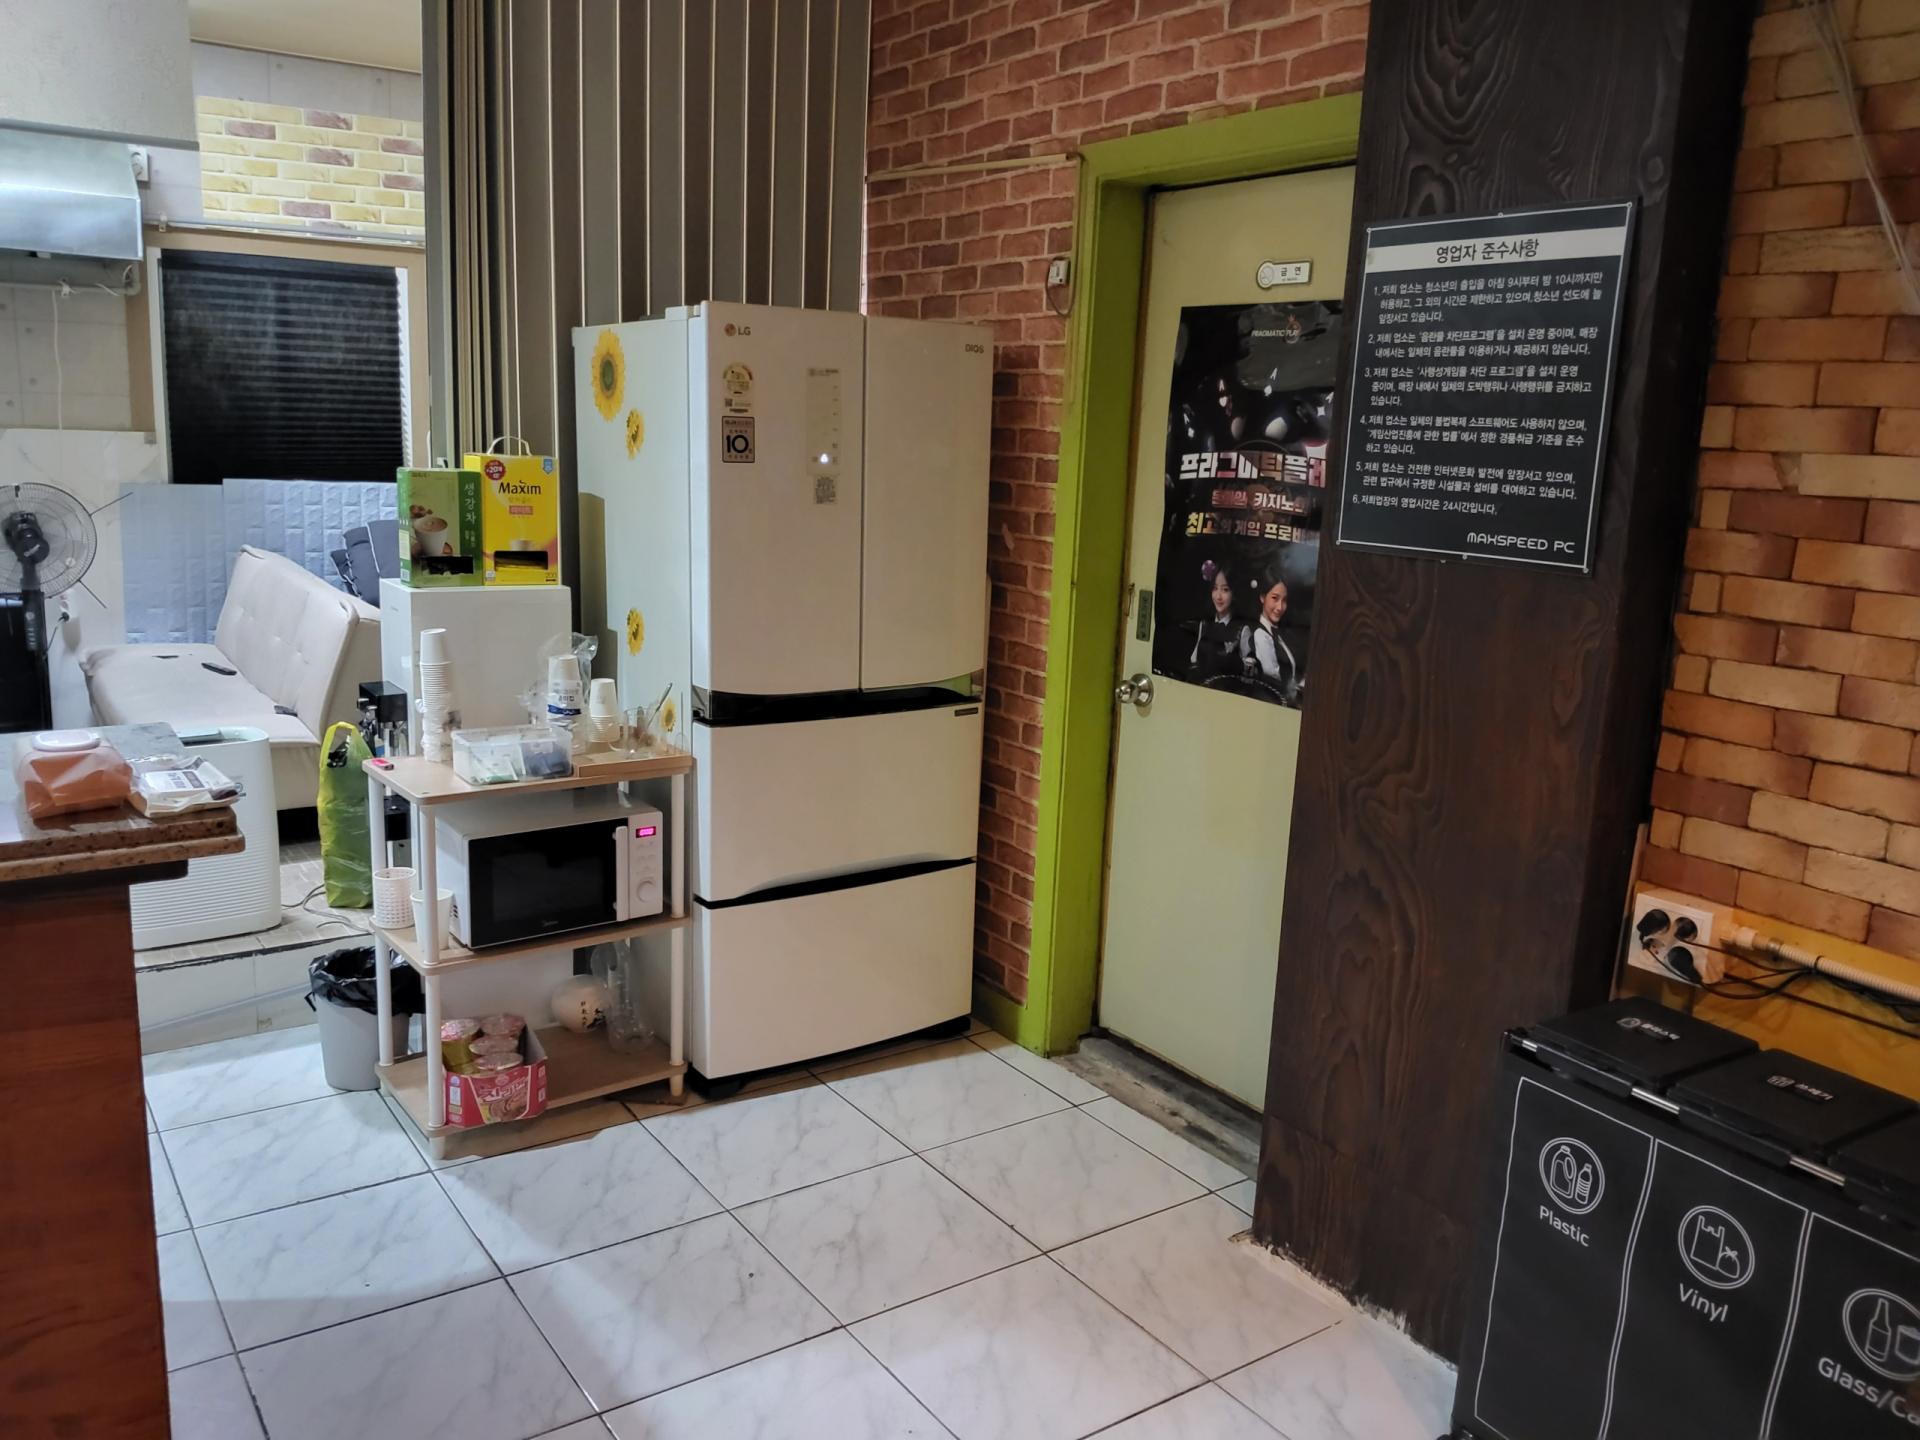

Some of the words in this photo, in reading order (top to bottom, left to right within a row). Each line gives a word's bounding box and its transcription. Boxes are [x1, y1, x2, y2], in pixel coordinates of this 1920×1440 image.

[1437, 243, 1477, 264] 영업자
[1482, 238, 1540, 260] 준수사항
[1382, 283, 1397, 295] 저희
[1400, 281, 1422, 294] 업소는
[1425, 280, 1457, 293] 청소년의
[1460, 278, 1485, 291] 출입을
[1487, 277, 1505, 289] 아침
[1507, 275, 1539, 287] 9시부터
[1542, 274, 1552, 287] 밤
[1555, 271, 1603, 285] 10시까지만
[1414, 298, 1423, 307] 그
[1425, 296, 1442, 308] 외의
[1443, 295, 1467, 307] 시간은
[1470, 293, 1502, 305] 제한하고
[1533, 289, 1560, 303] 청소년
[1562, 289, 1590, 301] 선도에
[738, 326, 751, 336] LG
[1377, 332, 1392, 344] 저희
[1393, 331, 1416, 344] 업소는
[1508, 328, 1525, 340] 설치
[1527, 327, 1545, 340] 운영
[1579, 326, 1598, 339] 매장
[1375, 346, 1405, 358] 내에서는
[1407, 346, 1432, 358] 일체의
[1433, 345, 1466, 357] 음란물을
[1468, 344, 1511, 357] 이용하거나
[1513, 343, 1549, 356] 제공하지
[1373, 367, 1389, 378] 저희
[1391, 366, 1414, 378] 업소는
[1469, 366, 1487, 377] 차단
[1539, 365, 1557, 377] 설치
[1560, 365, 1579, 377] 운영
[1398, 381, 1414, 392] 매장
[1416, 381, 1439, 391] 내에서
[1441, 381, 1465, 392] 일체의
[1466, 381, 1509, 392] 도박행위나
[1555, 381, 1592, 393] 금지하고
[1369, 415, 1383, 425] 저희
[1385, 415, 1408, 426] 업소는
[1409, 416, 1433, 426] 일체의
[1468, 416, 1518, 428] 소프트웨어도
[1520, 417, 1556, 429] 사용하지
[726, 434, 749, 454] 10
[1423, 430, 1440, 441] 관한
[1480, 432, 1497, 443] 정한
[1536, 434, 1563, 446] 기준을
[1565, 434, 1585, 447] 준수
[1365, 443, 1380, 453] 하고
[1364, 462, 1379, 472] 저희
[1382, 462, 1404, 473] 업소는
[1407, 463, 1431, 475] 건전한
[1434, 464, 1475, 477] 인터넷문화
[1478, 467, 1504, 480] 발전에
[1506, 468, 1542, 481] 앞장서고
[499, 480, 542, 495] Maxim
[1362, 475, 1378, 486] 관련
[1380, 476, 1410, 488] 법규에서
[1412, 478, 1436, 490] 규정한
[1438, 479, 1471, 492] 시설물과
[1473, 481, 1499, 494] 설비를
[1501, 483, 1536, 496] 대여하고
[464, 482, 477, 525] 생강차
[1361, 494, 1398, 507] 저희업장의
[1400, 497, 1440, 510] 영업시간은
[1466, 531, 1549, 551] MAXSPEED
[1553, 541, 1576, 554] PC
[1539, 1205, 1590, 1247] Plastic
[1679, 1283, 1729, 1323] Vinyl
